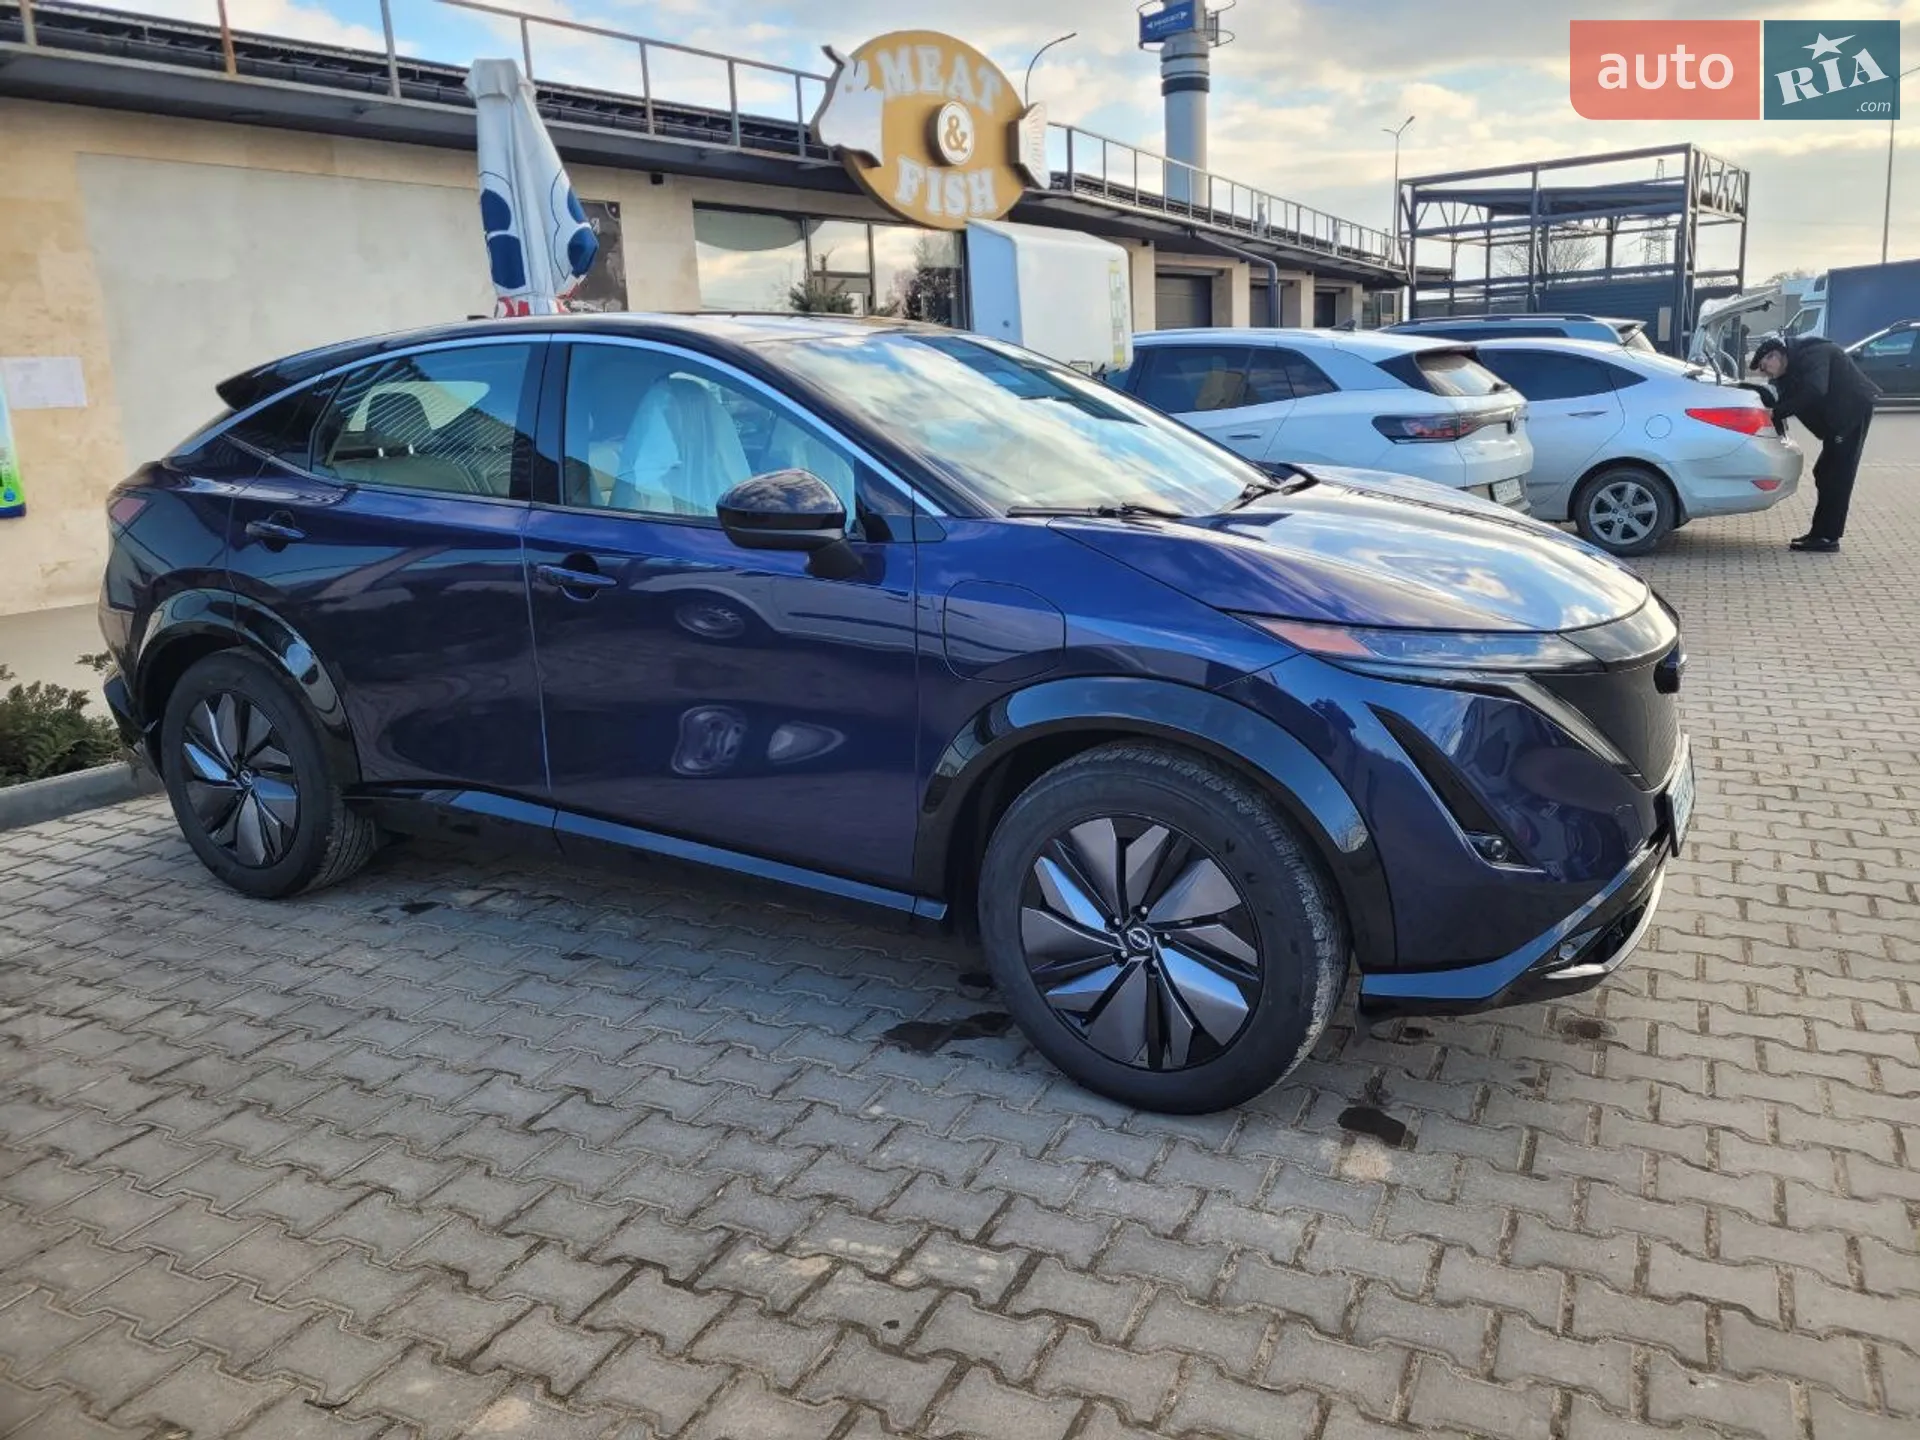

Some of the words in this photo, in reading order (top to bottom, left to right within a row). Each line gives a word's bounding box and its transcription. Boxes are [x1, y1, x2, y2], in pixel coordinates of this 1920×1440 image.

[876, 44, 1001, 115] MEAT
[943, 115, 967, 152] &
[895, 155, 998, 217] FISH
